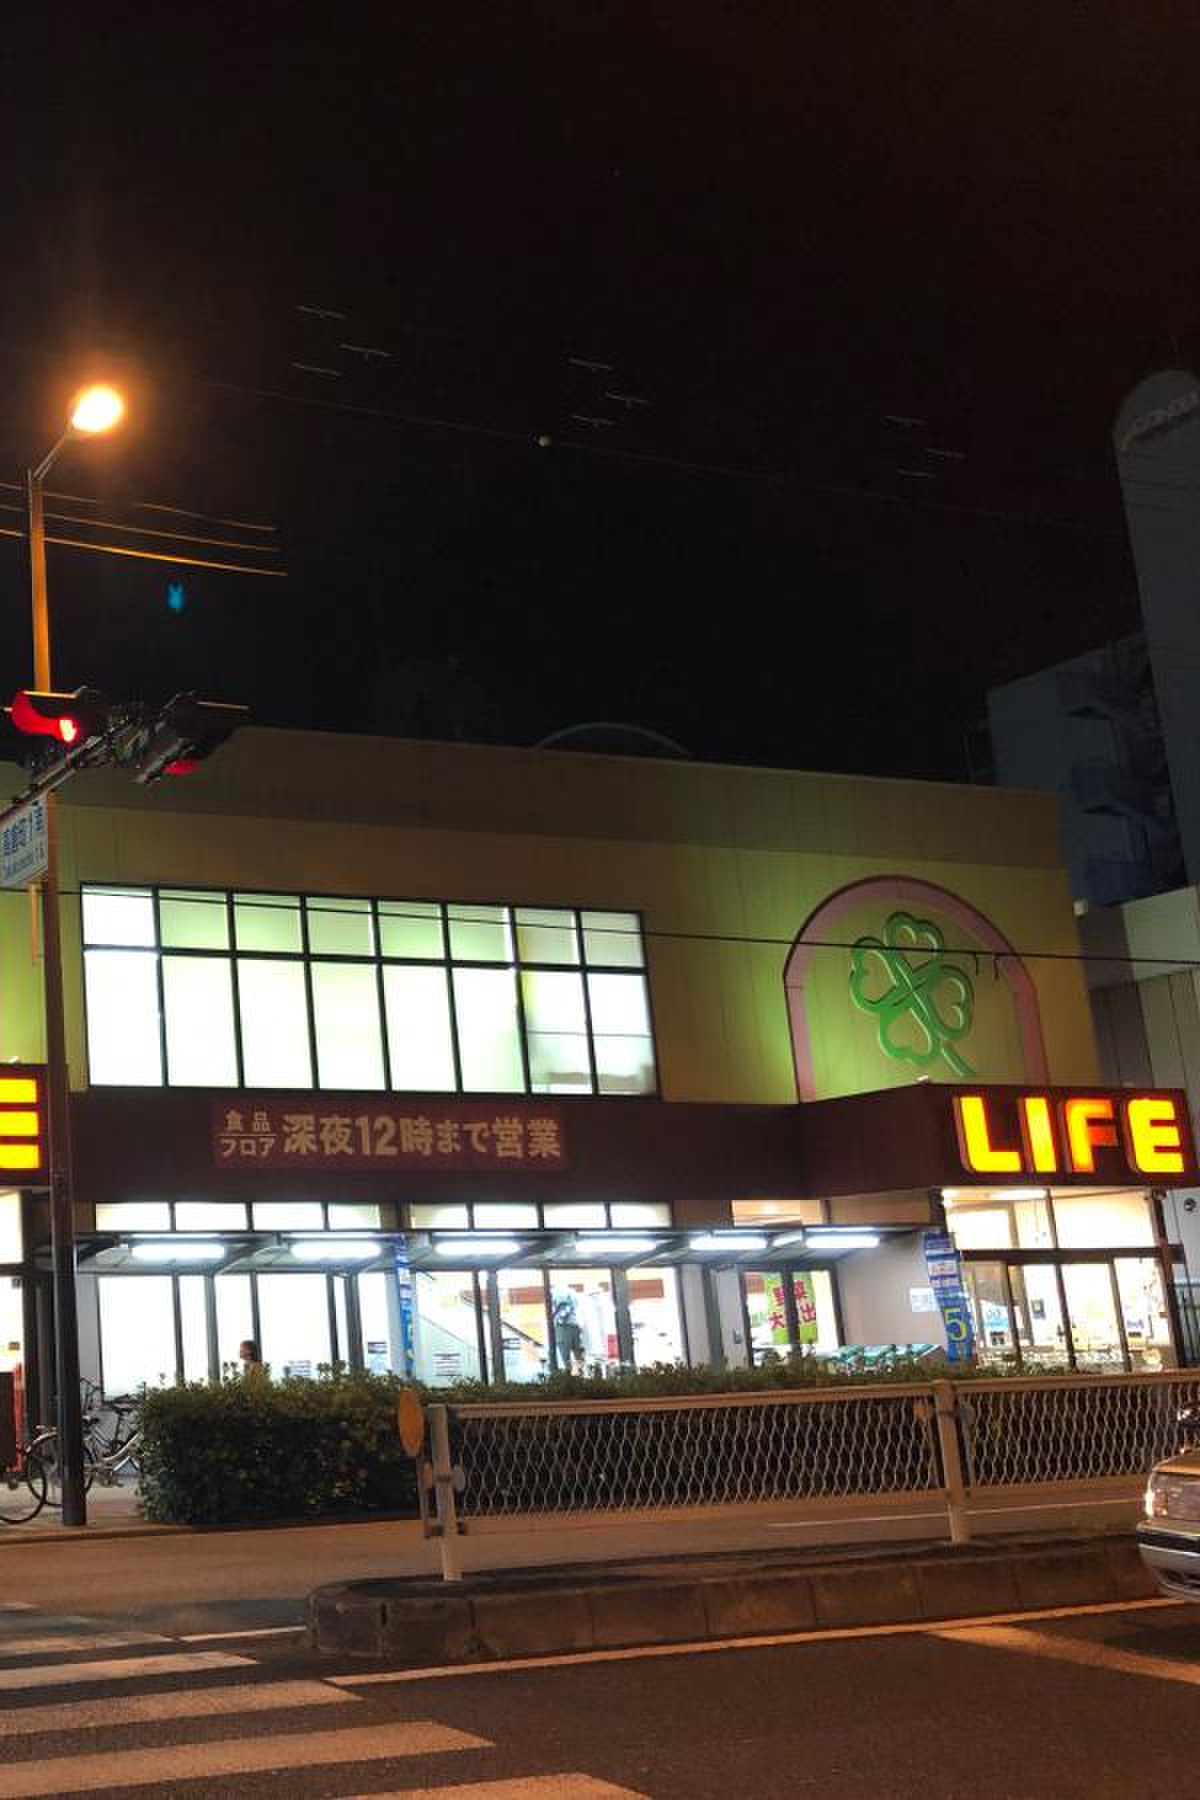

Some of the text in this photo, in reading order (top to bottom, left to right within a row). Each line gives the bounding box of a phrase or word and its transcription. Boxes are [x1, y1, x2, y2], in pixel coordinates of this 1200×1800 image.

[225, 1110, 271, 1132] 食品
[282, 1113, 562, 1158] 深夜12時まで営業
[956, 1096, 1185, 1173] LIFE
[220, 1138, 275, 1157] フロア
